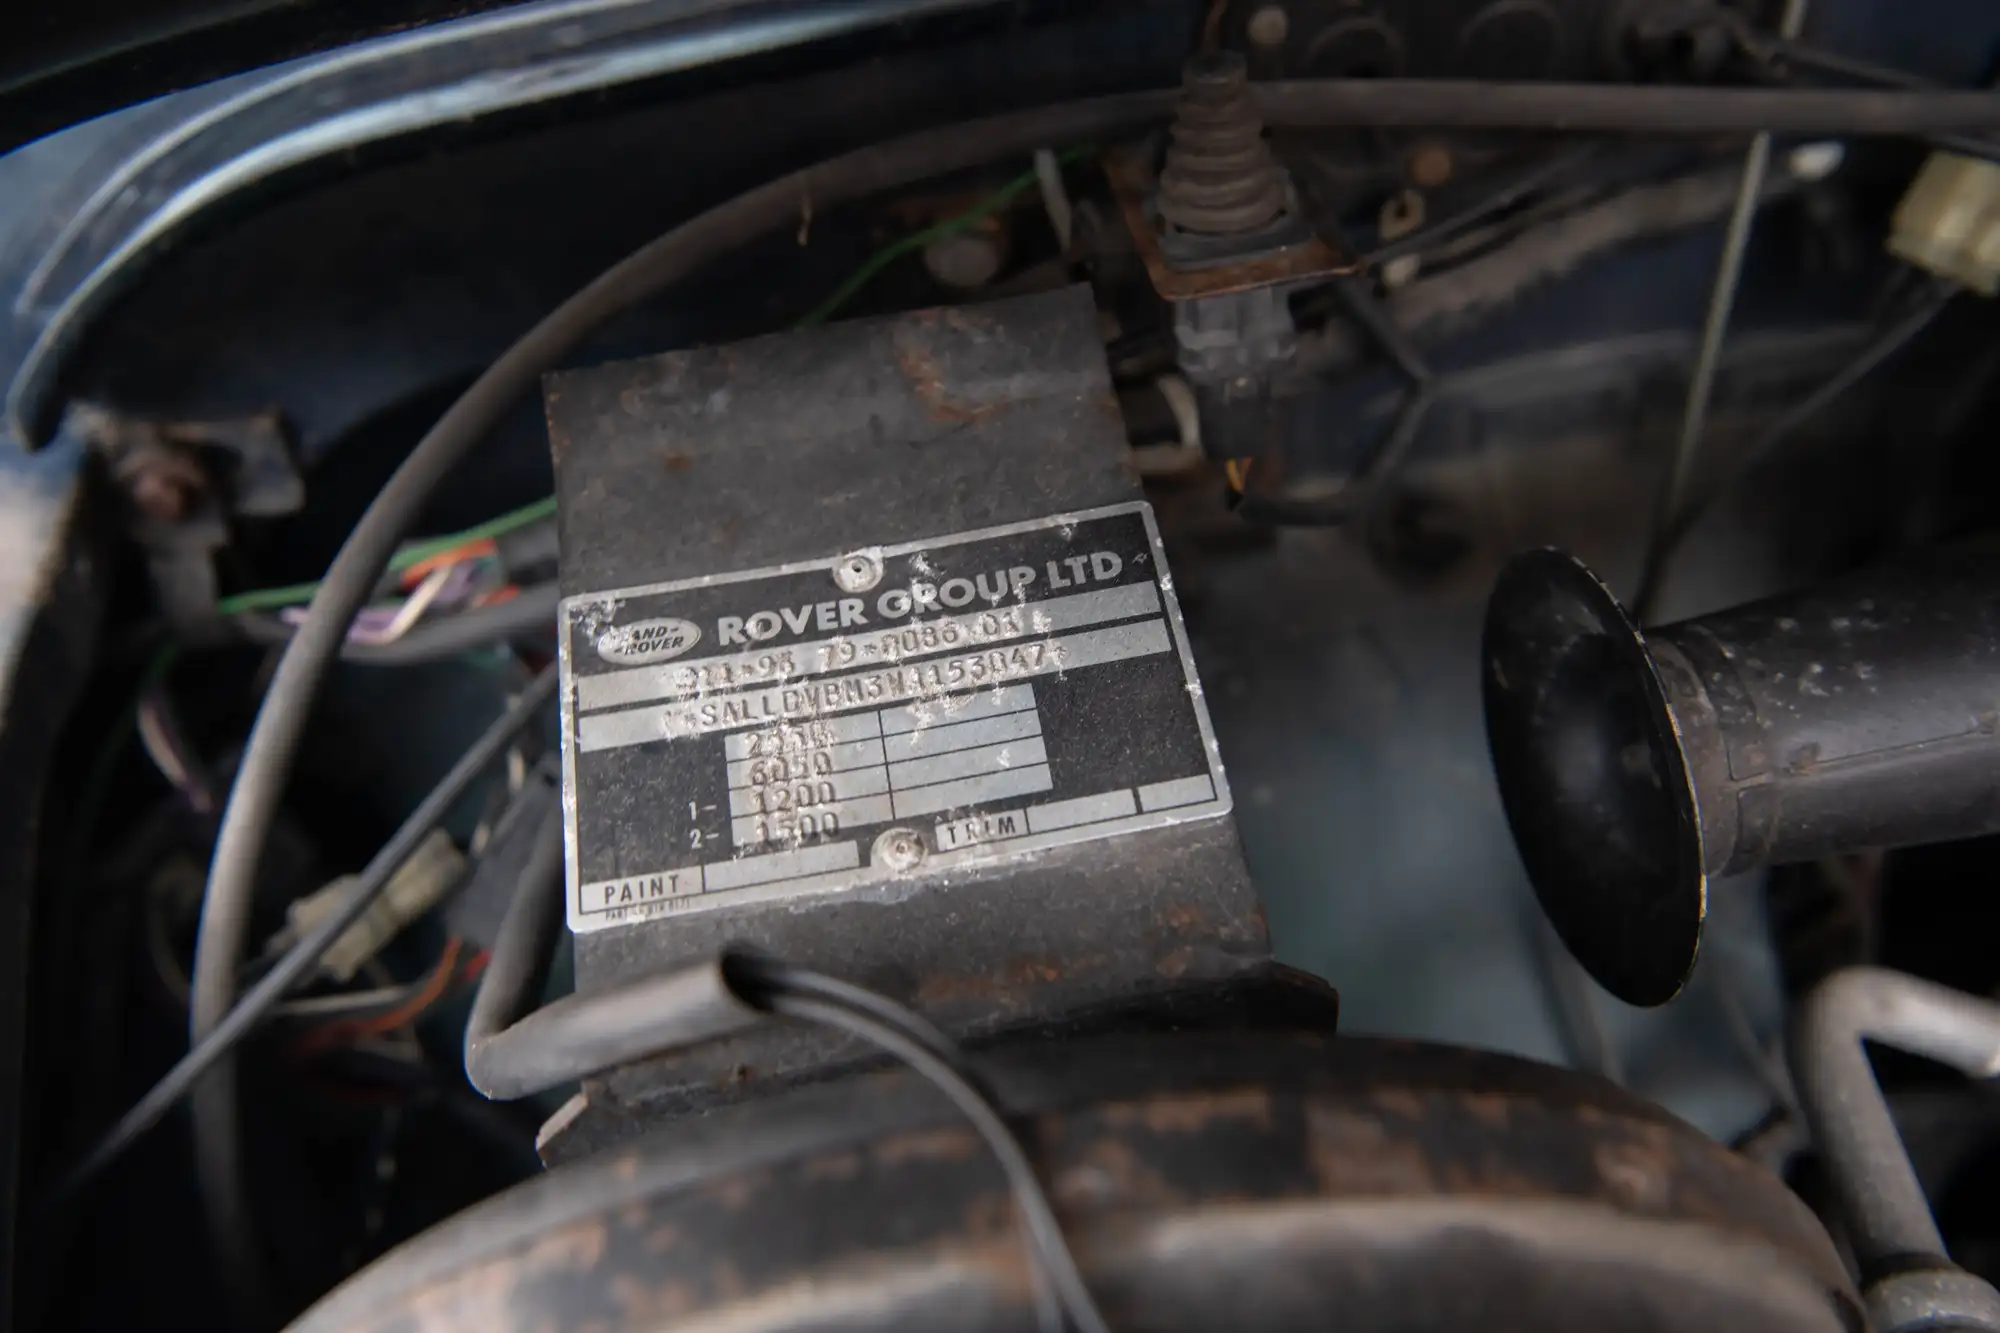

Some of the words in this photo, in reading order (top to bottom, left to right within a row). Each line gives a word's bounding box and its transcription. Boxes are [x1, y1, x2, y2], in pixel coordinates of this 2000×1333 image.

[717, 597, 865, 648] ROVER
[877, 565, 1037, 622] GROUP
[1046, 551, 1123, 590] LTD
[620, 626, 680, 646] AND-
[752, 780, 836, 816] 1200
[755, 811, 840, 846] 1500
[947, 815, 1016, 845] TRIM
[604, 874, 679, 905] PAINT
